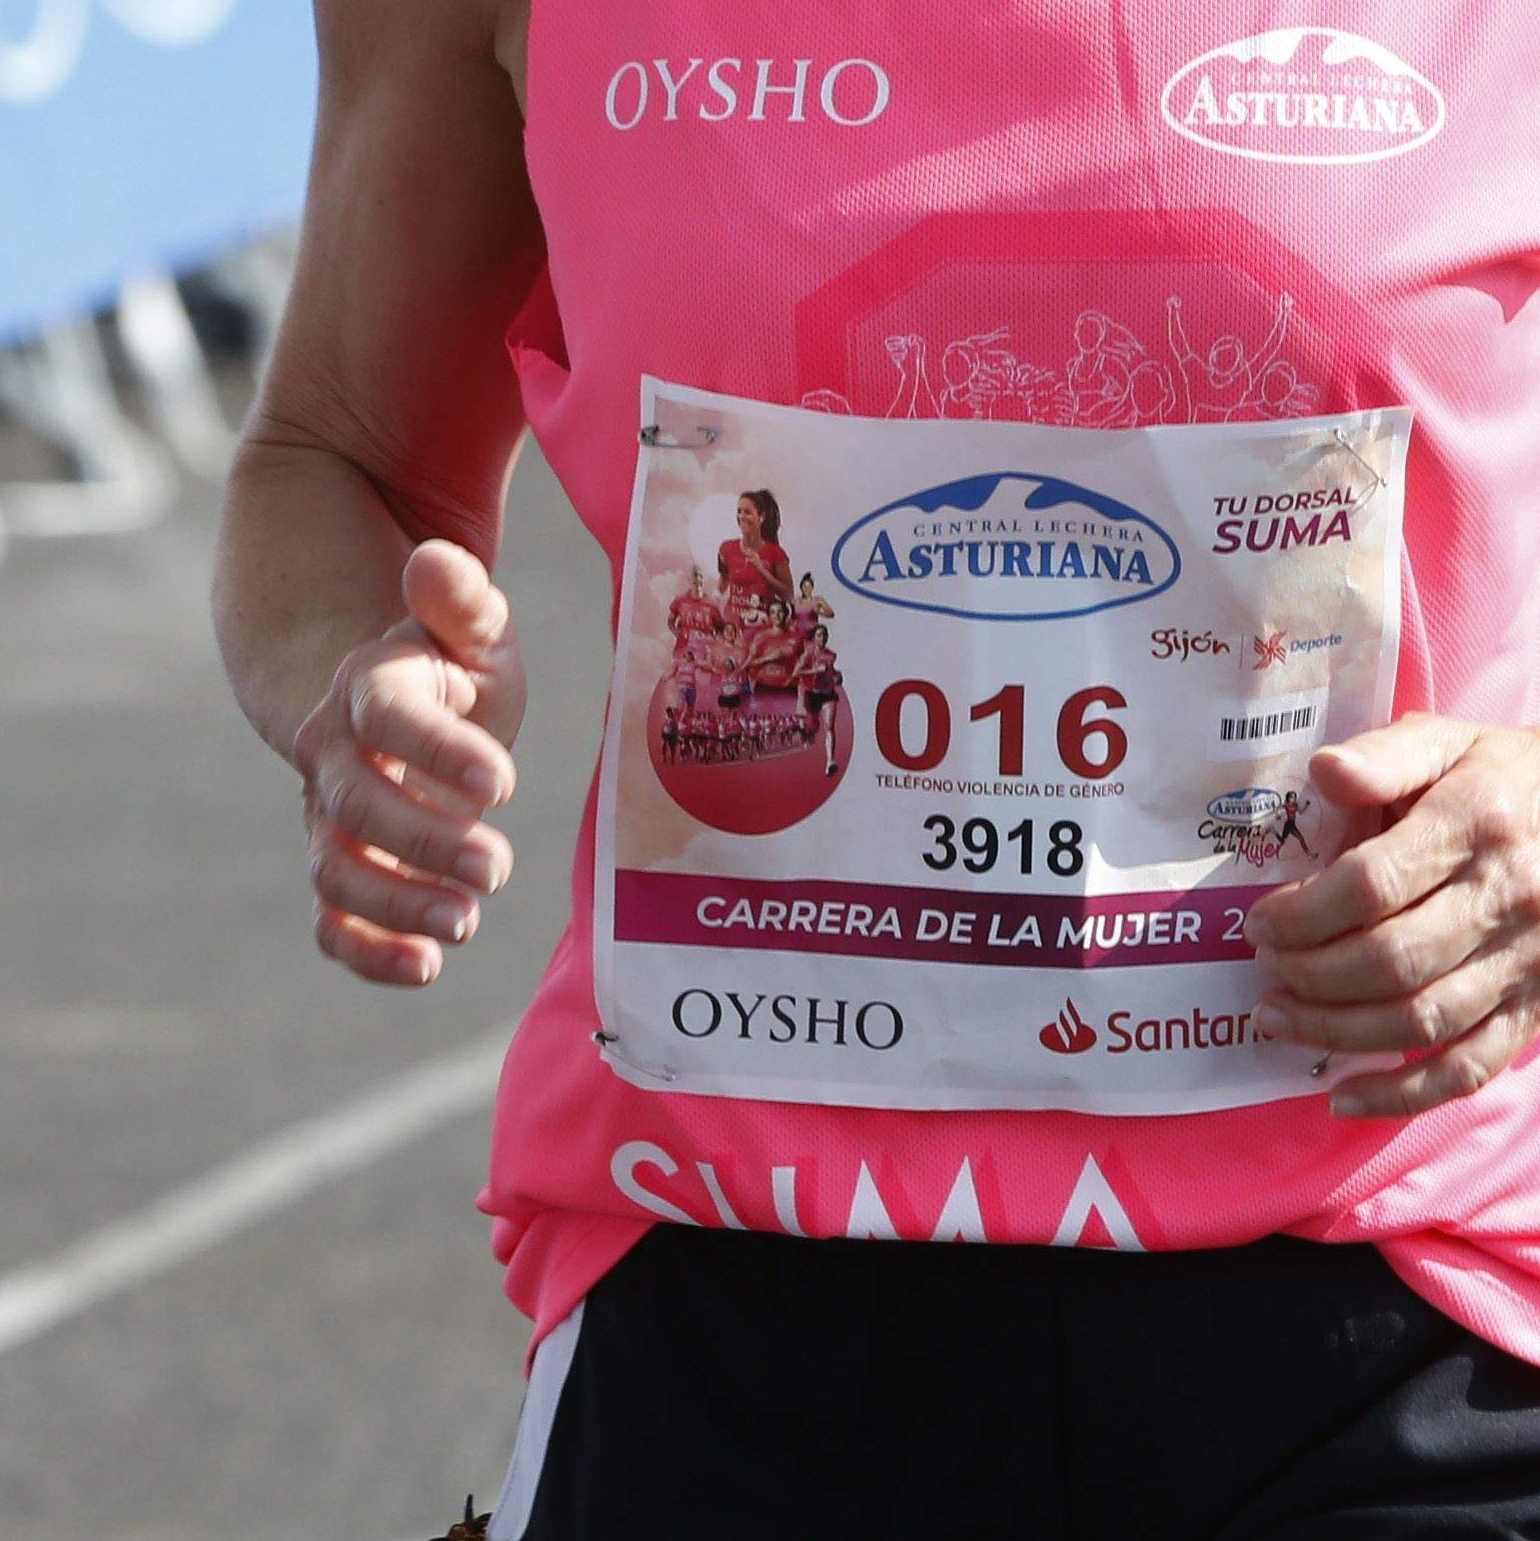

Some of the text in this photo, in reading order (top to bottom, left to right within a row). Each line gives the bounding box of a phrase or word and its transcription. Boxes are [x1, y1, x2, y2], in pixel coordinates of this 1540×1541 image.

[605, 57, 891, 131] OYSHO
[1184, 74, 1425, 134] ASTURIANA
[1213, 487, 1358, 516] TU DORSAL
[913, 519, 1144, 543] CENTRAL LECHERA
[1212, 510, 1352, 554] SUMA
[858, 530, 1155, 586] ASTURIANA
[1151, 627, 1230, 662] gijón
[1291, 633, 1342, 654] Deporte
[875, 678, 1128, 780] 016
[876, 773, 1125, 798] TELÉFONO VIOLENCIA DE GÉNERO
[922, 814, 1084, 877] 3918
[1198, 820, 1261, 841] Carrera
[696, 895, 903, 940] CARRERA
[915, 909, 977, 944] DE
[987, 913, 1042, 948] LA
[1056, 910, 1202, 949] MUJER
[672, 989, 904, 1051] OYSHO
[1107, 1007, 1273, 1054] Santan
